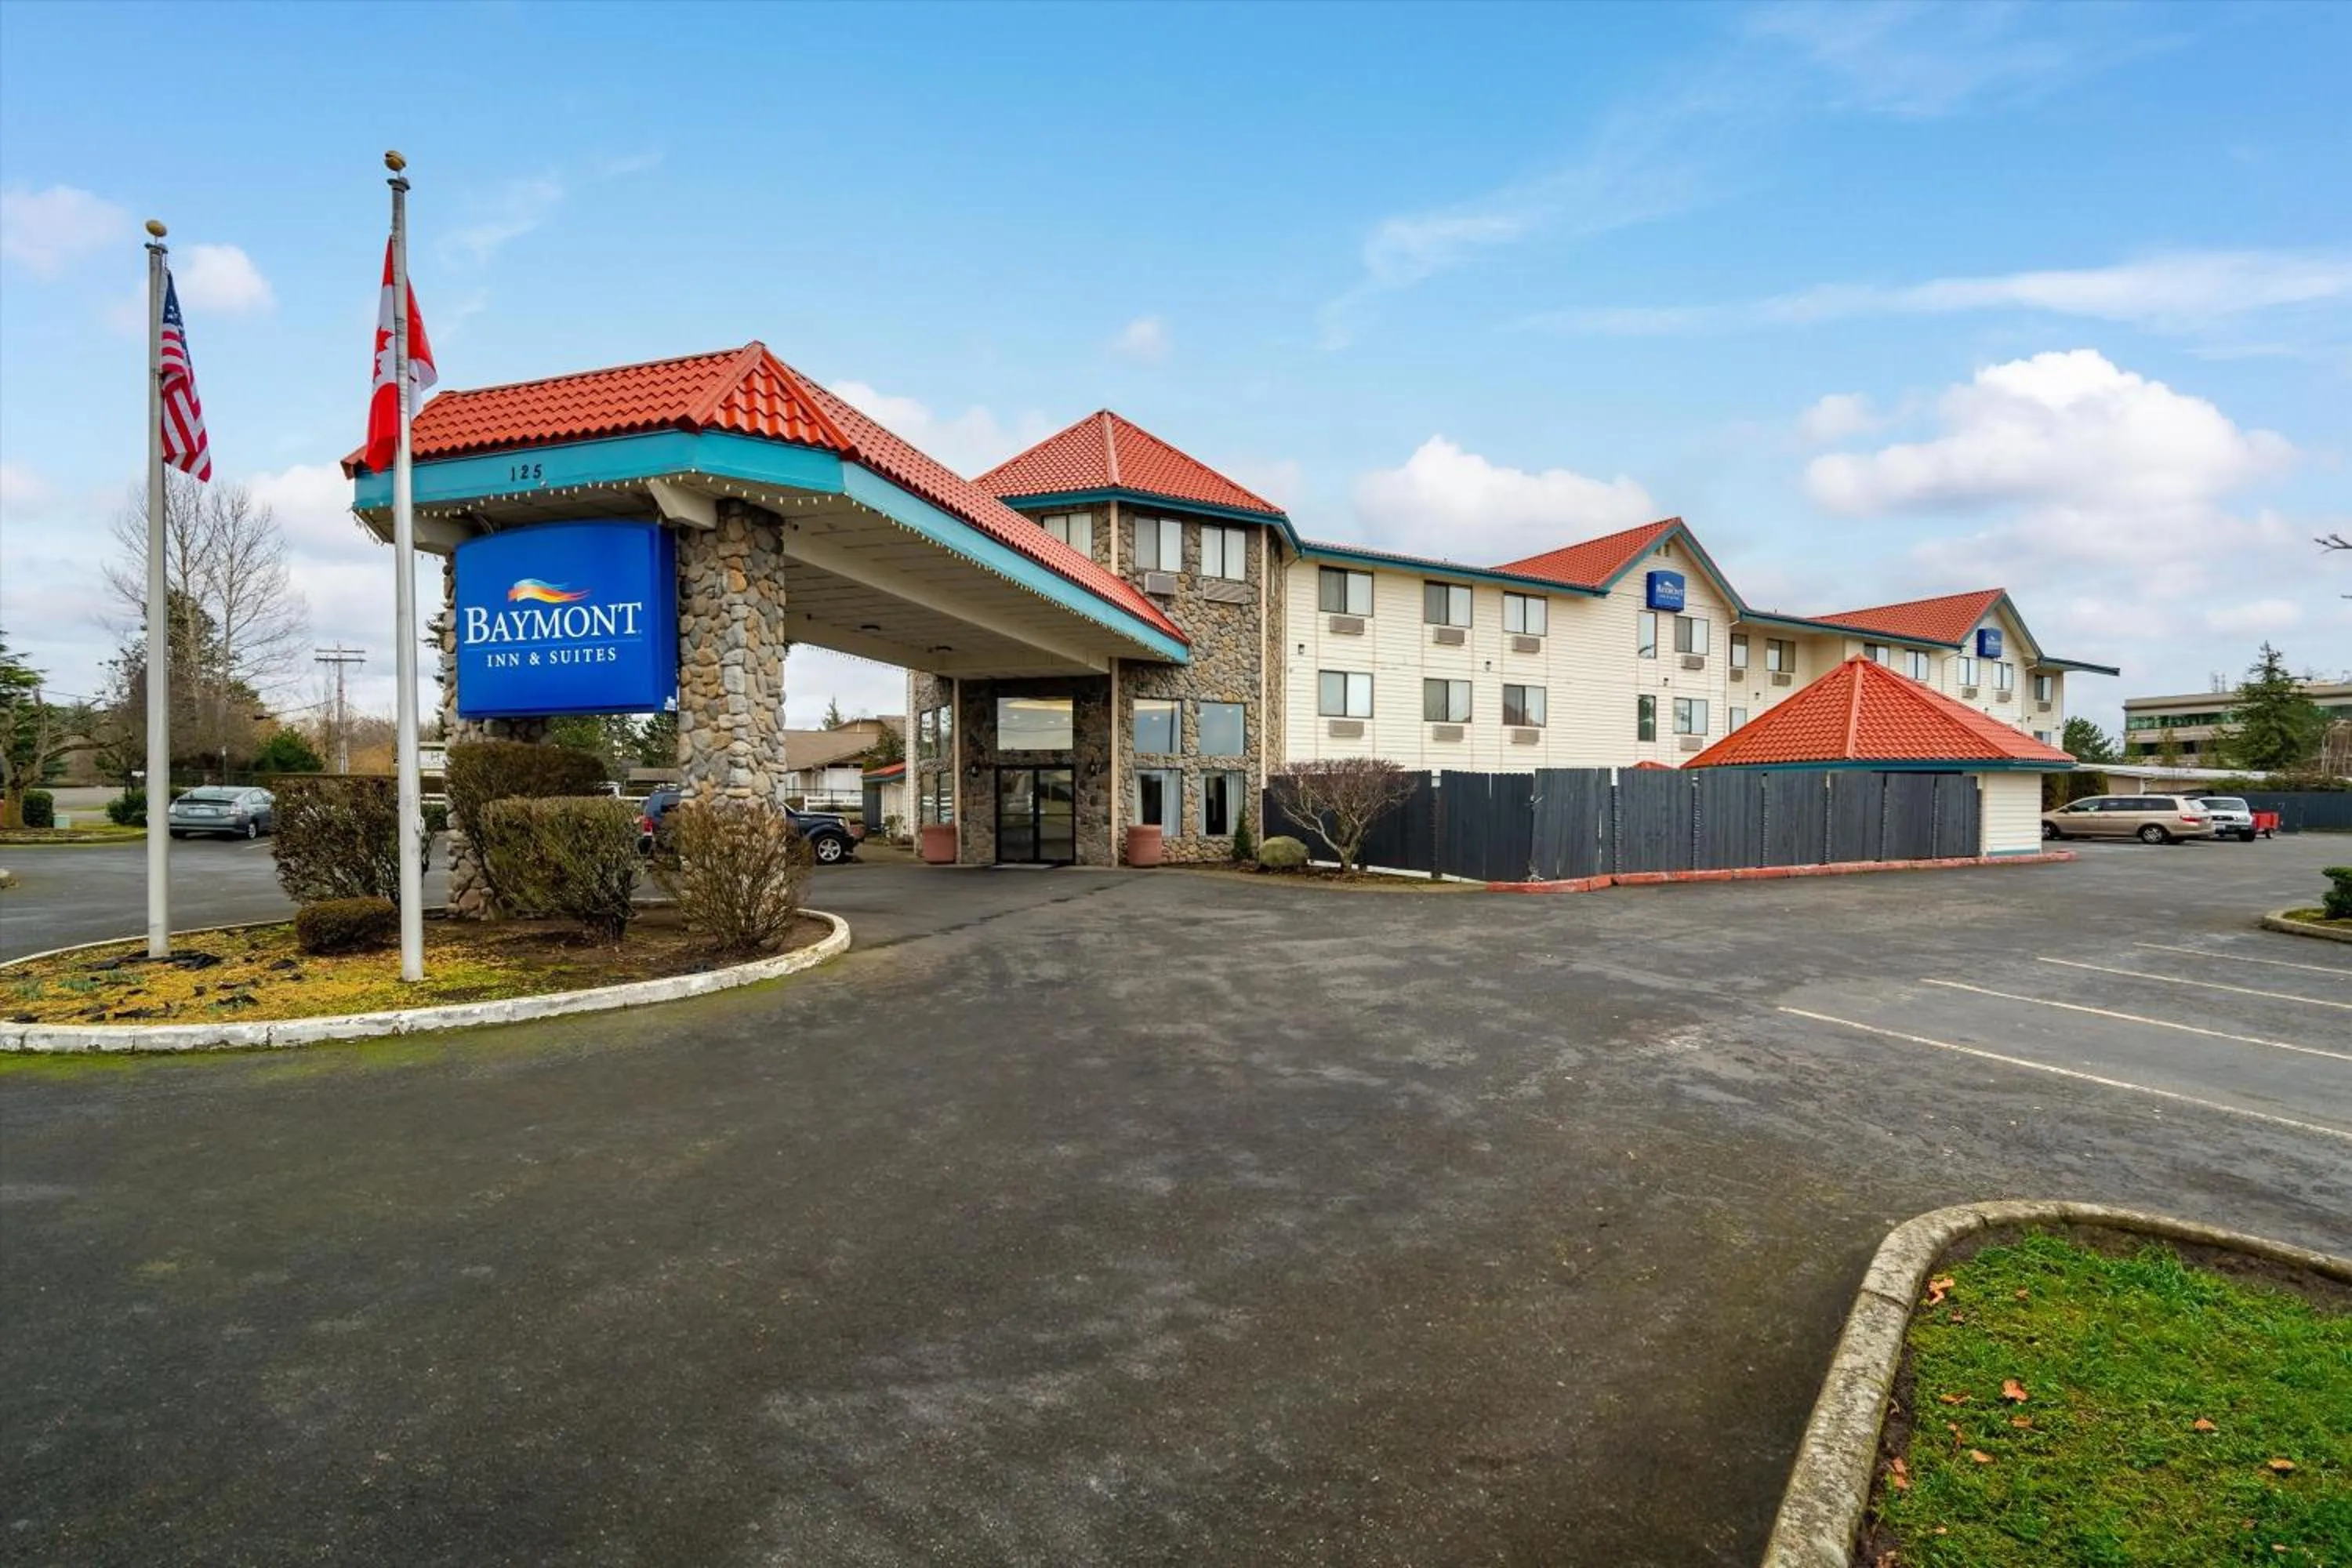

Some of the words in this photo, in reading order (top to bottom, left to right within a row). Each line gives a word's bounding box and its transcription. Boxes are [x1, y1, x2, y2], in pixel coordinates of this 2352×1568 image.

[511, 464, 542, 482] 125
[463, 602, 642, 644] BAYMONT
[487, 652, 520, 667] INN
[529, 652, 540, 666] &
[550, 647, 616, 665] SUITES
